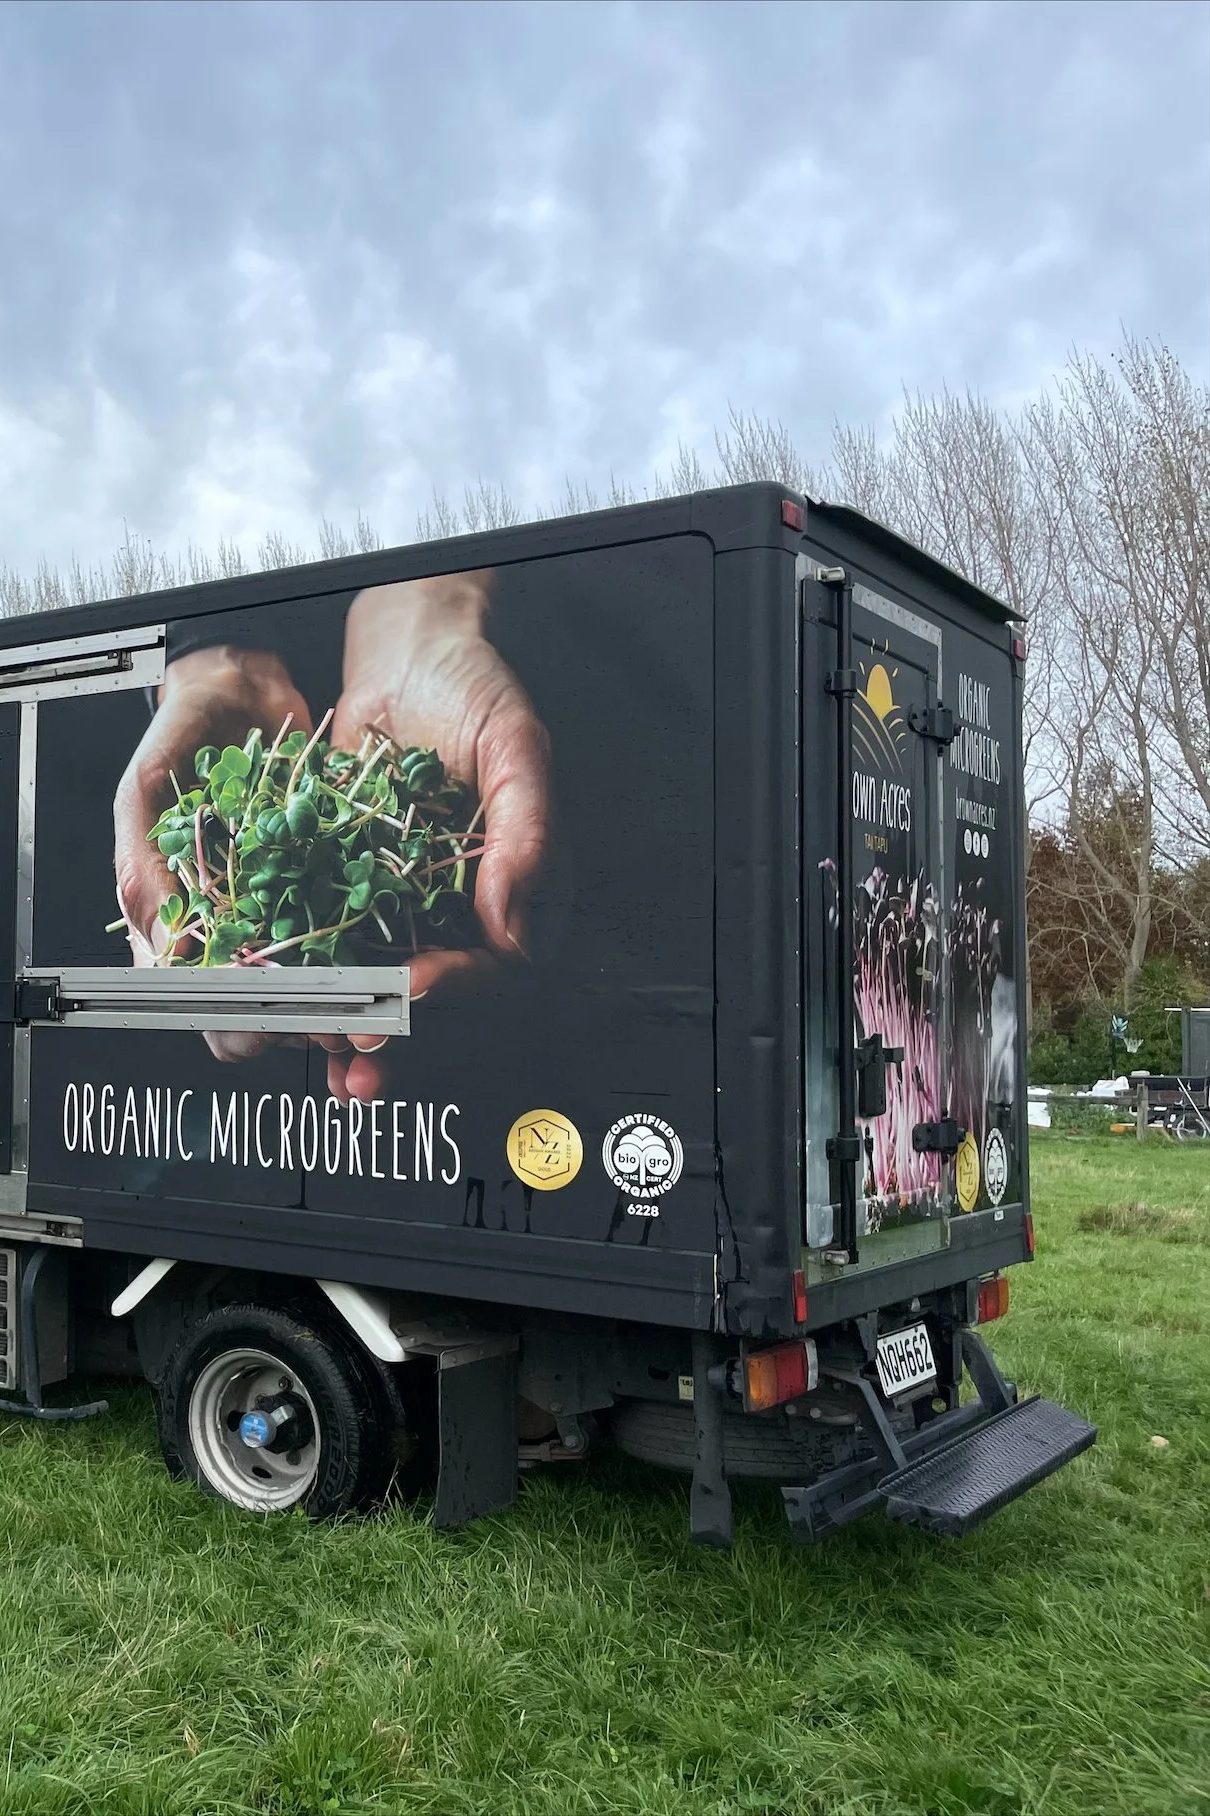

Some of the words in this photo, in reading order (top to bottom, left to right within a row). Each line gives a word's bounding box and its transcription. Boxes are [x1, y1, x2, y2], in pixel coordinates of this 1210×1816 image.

[958, 672, 991, 731] ORGANIC
[950, 726, 1001, 785] MICROGREENS
[853, 771, 876, 824] own
[880, 779, 911, 833] Acres
[63, 1082, 194, 1162] ORGANIC
[210, 1090, 462, 1186] MICROGREENS
[610, 1113, 675, 1138] CERTIFIED
[613, 1175, 673, 1198] ORGANIC
[618, 1153, 636, 1163] bio
[649, 1158, 669, 1168] gro
[626, 1203, 660, 1217] 6228
[876, 1332, 933, 1388] NQH662
